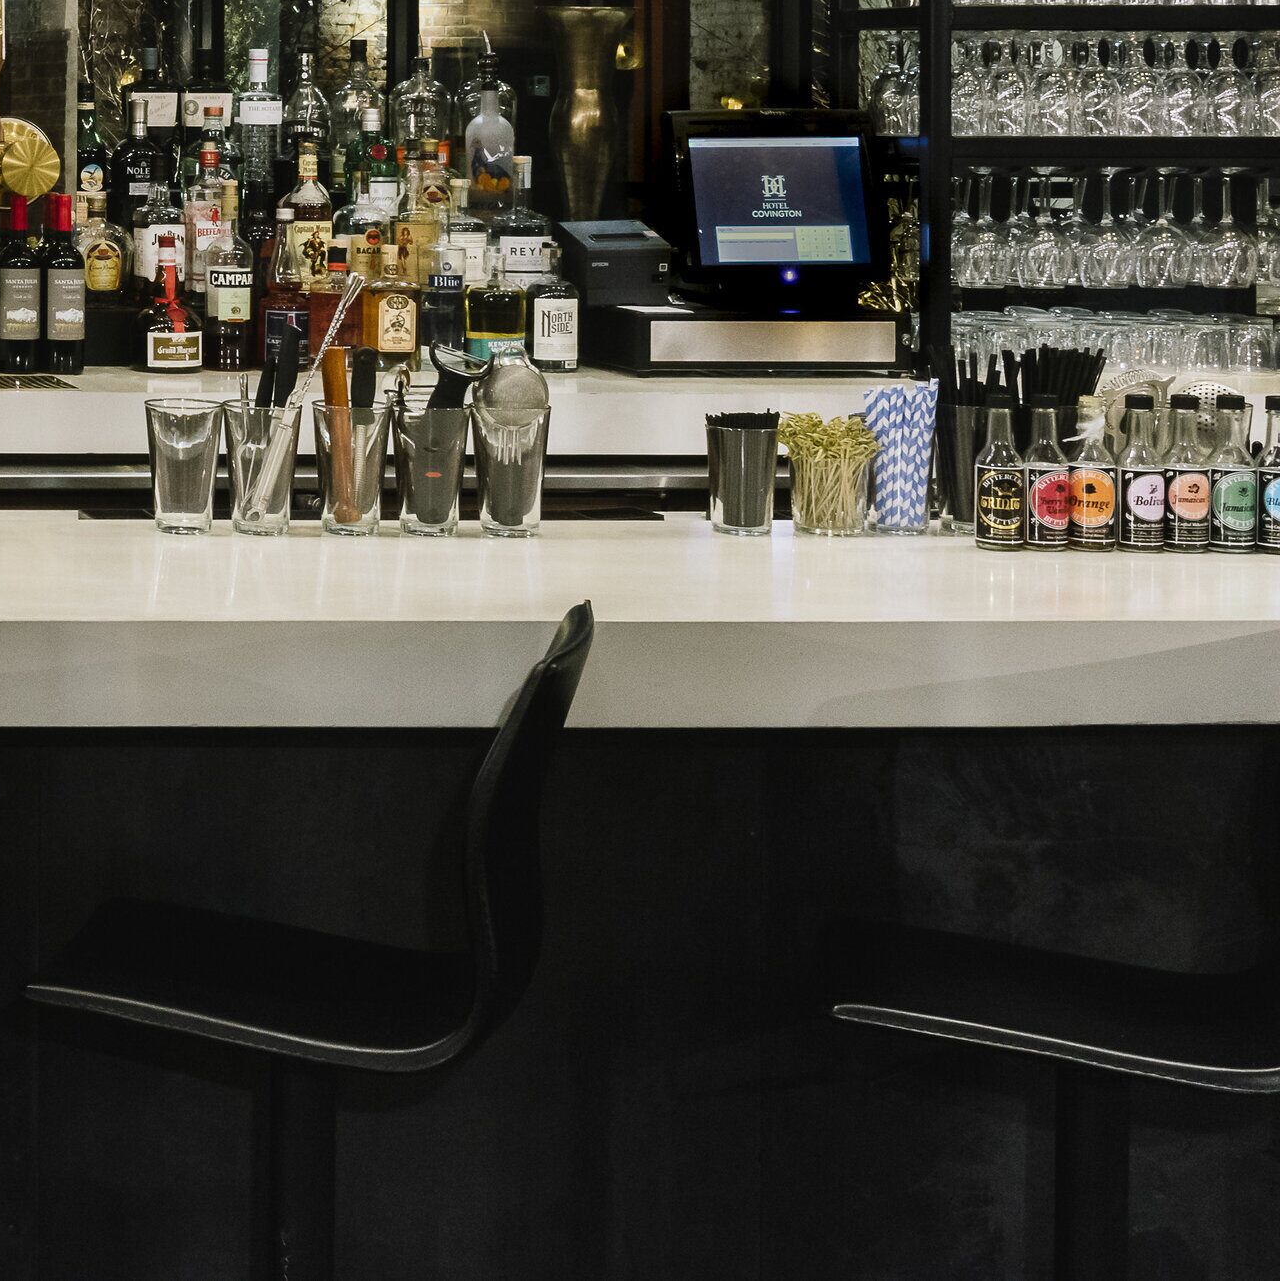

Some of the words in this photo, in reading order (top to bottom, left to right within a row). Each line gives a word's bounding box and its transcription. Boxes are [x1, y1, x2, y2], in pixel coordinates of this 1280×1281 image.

[126, 166, 150, 175] NOLE
[751, 210, 802, 218] COVINGTON
[356, 247, 381, 255] BACAR
[434, 275, 460, 287] Blüe
[541, 310, 573, 338] NORTH
[551, 322, 570, 334] SIDE
[1070, 494, 1111, 512] Orange
[1172, 494, 1206, 504] Jamaican
